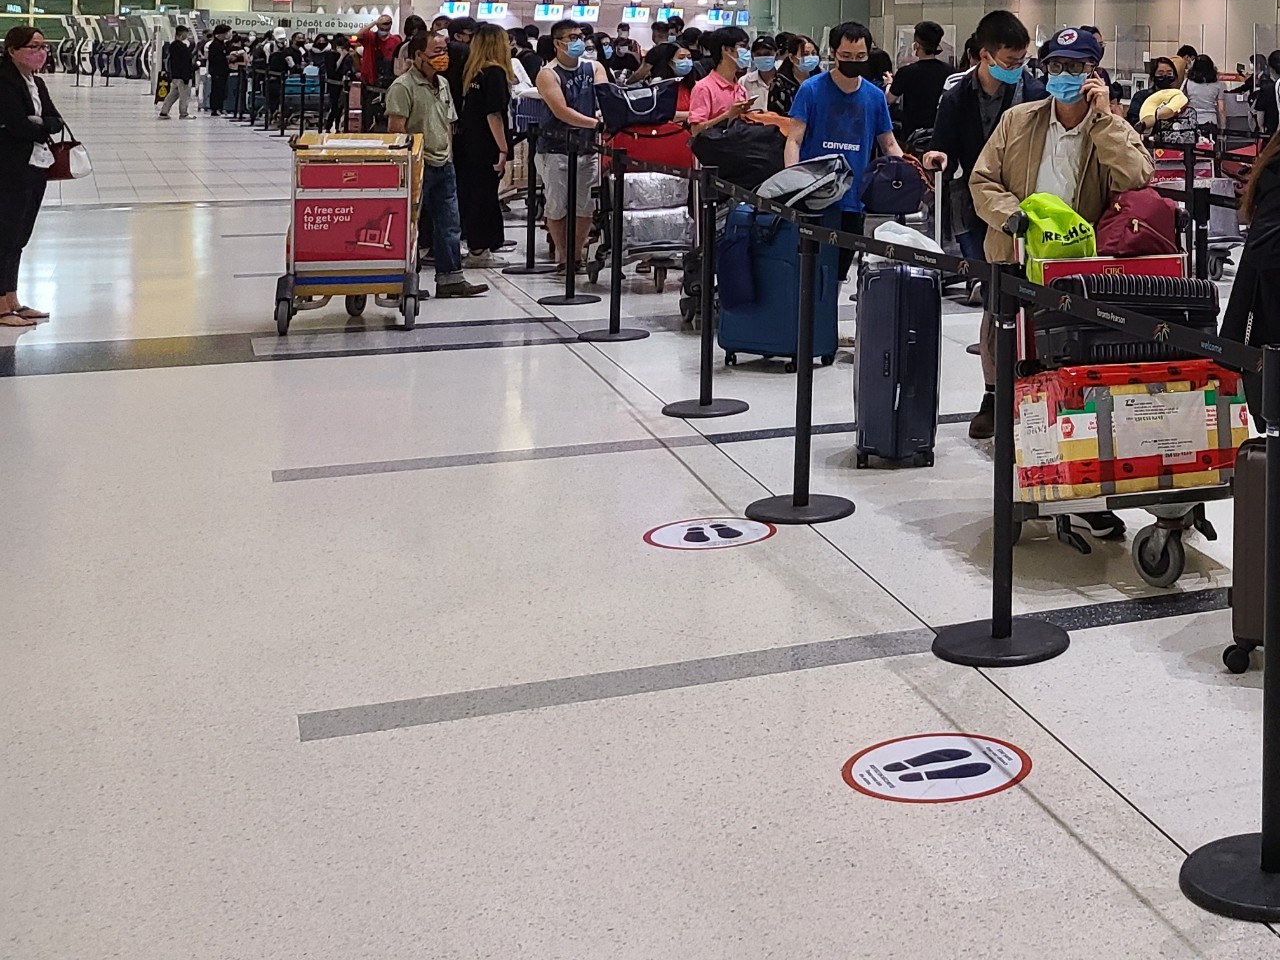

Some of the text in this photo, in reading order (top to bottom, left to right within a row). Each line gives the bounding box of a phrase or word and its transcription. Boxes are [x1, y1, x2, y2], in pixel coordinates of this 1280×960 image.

[296, 15, 322, 28] Dépôt
[324, 17, 336, 28] de
[822, 140, 861, 152] CONVERSE
[303, 205, 355, 215] A free cart
[303, 214, 351, 224] to get you
[303, 222, 330, 231] there
[1096, 307, 1126, 325] Toronto Pearson
[1200, 340, 1223, 354] welcome
